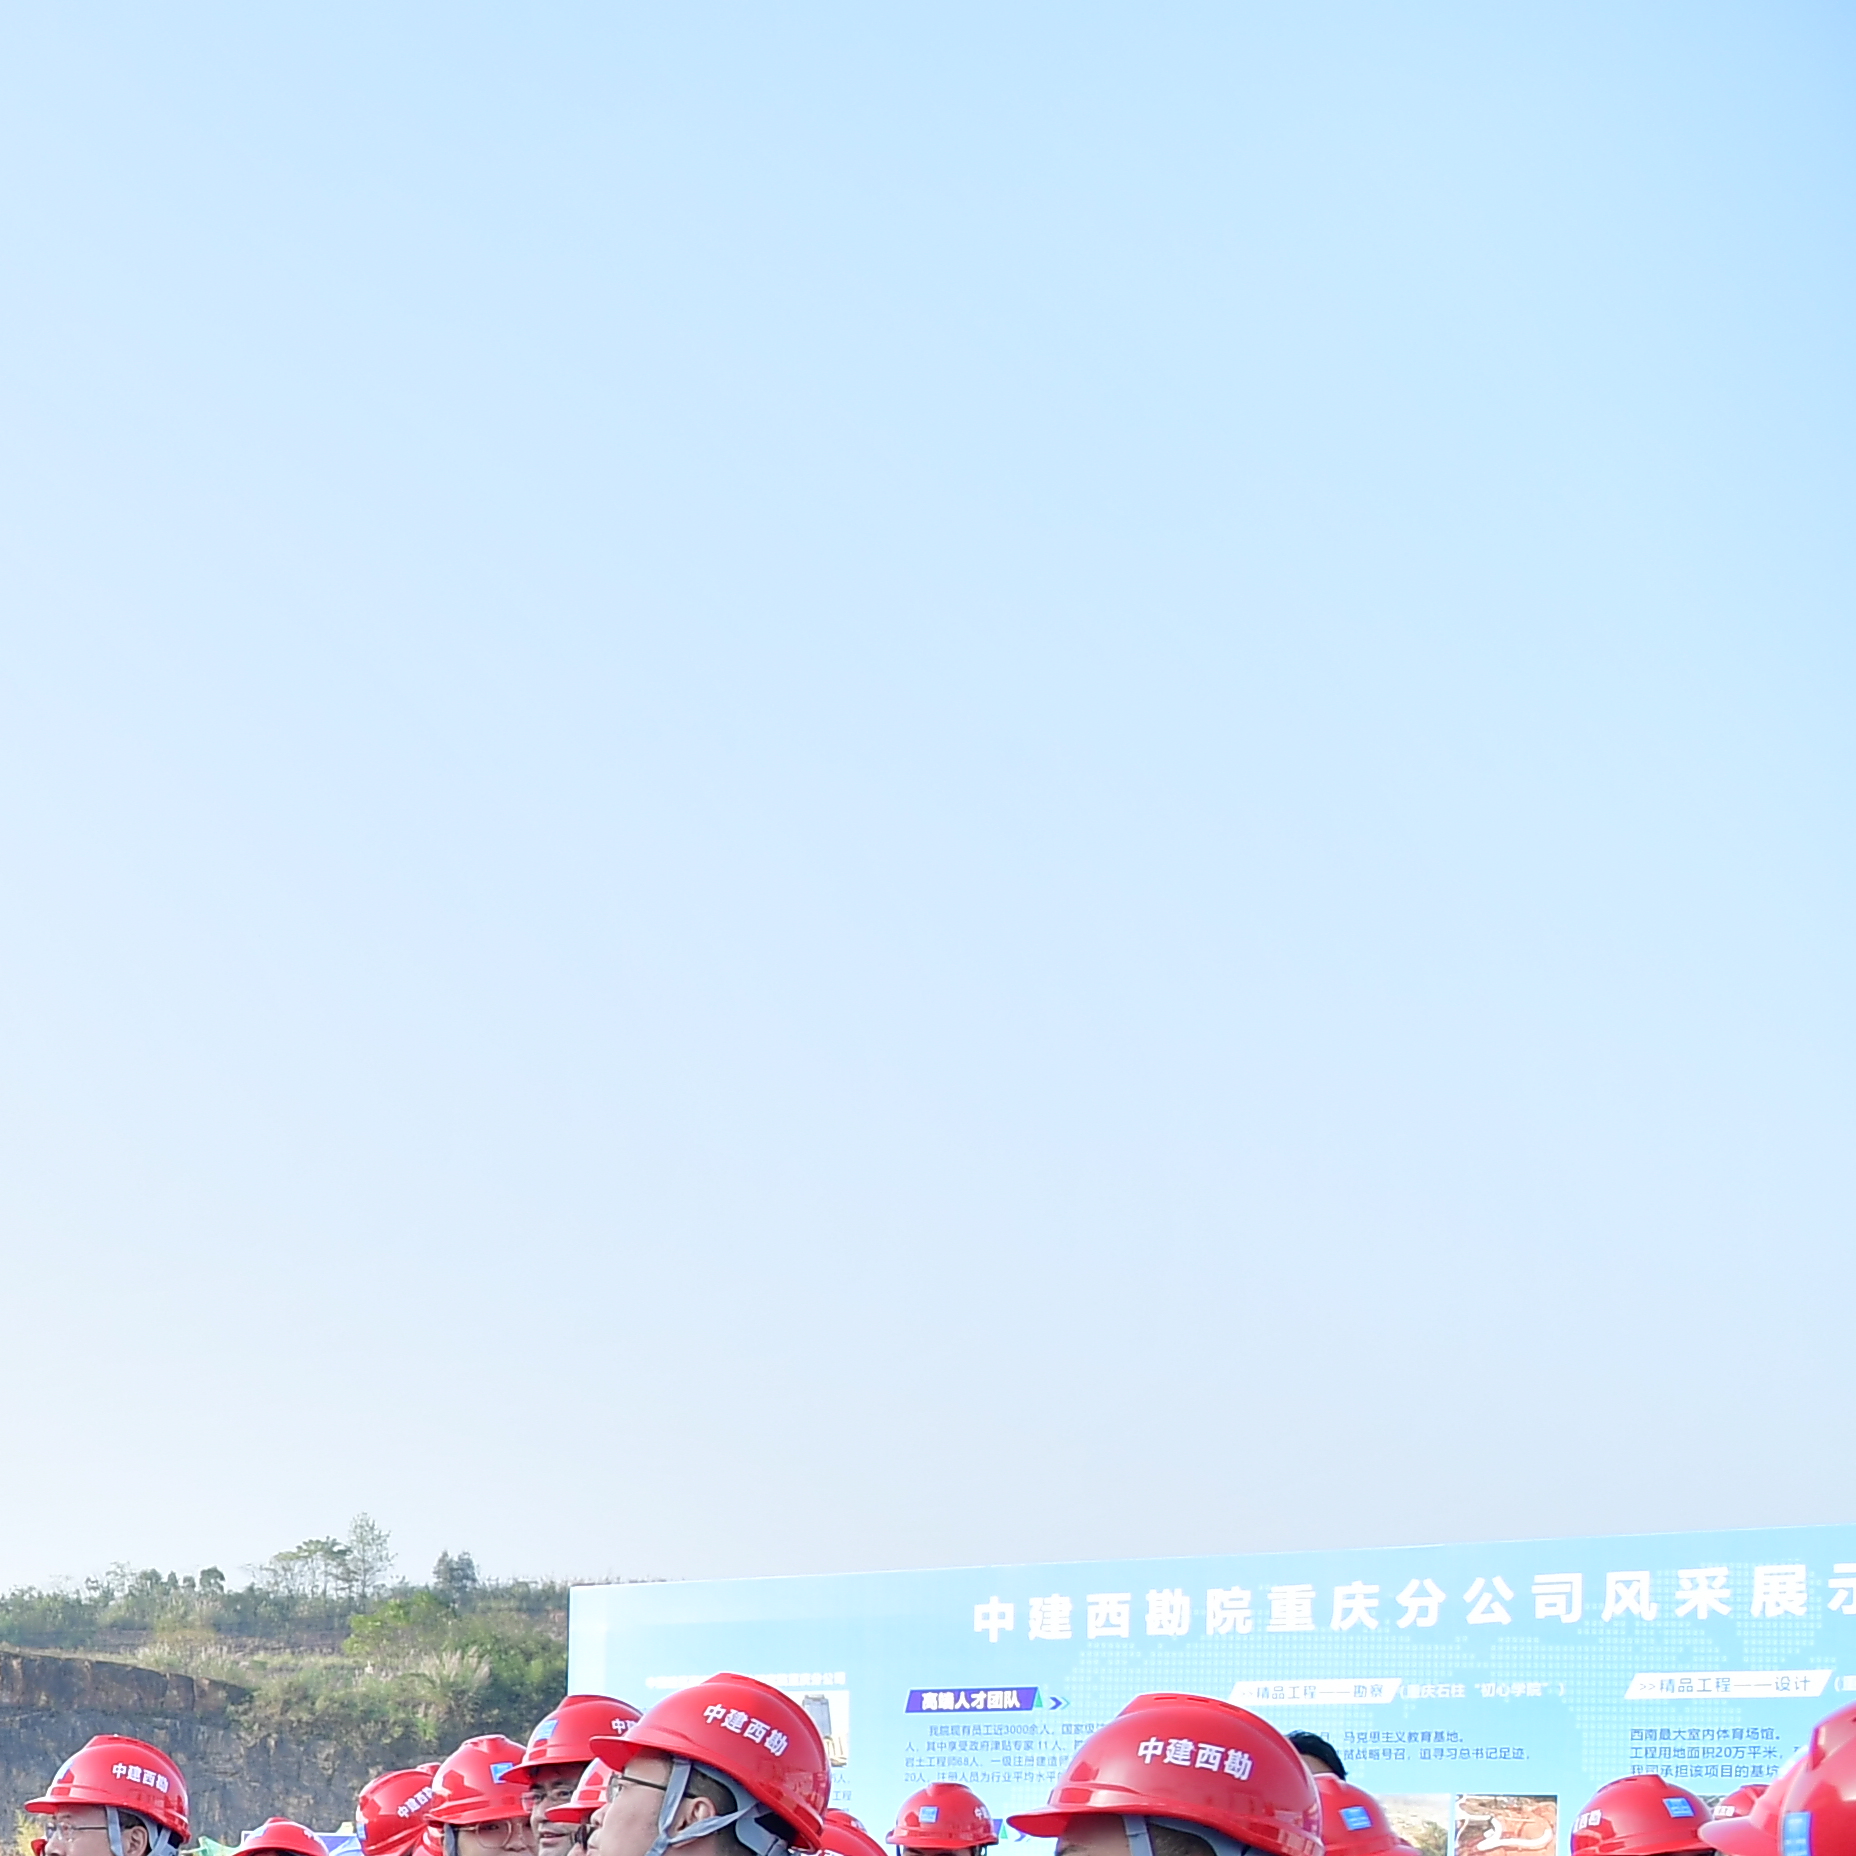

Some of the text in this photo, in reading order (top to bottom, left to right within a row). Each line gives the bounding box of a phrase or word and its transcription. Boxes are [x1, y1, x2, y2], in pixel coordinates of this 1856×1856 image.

[921, 1690, 1021, 1711] 高端人才团队
[702, 1703, 790, 1757] 中建西勘
[1629, 1727, 1781, 1742] 西南最大室内体育场馆。
[1137, 1736, 1255, 1782] 中建西勘
[111, 1762, 170, 1794] 中建西勘
